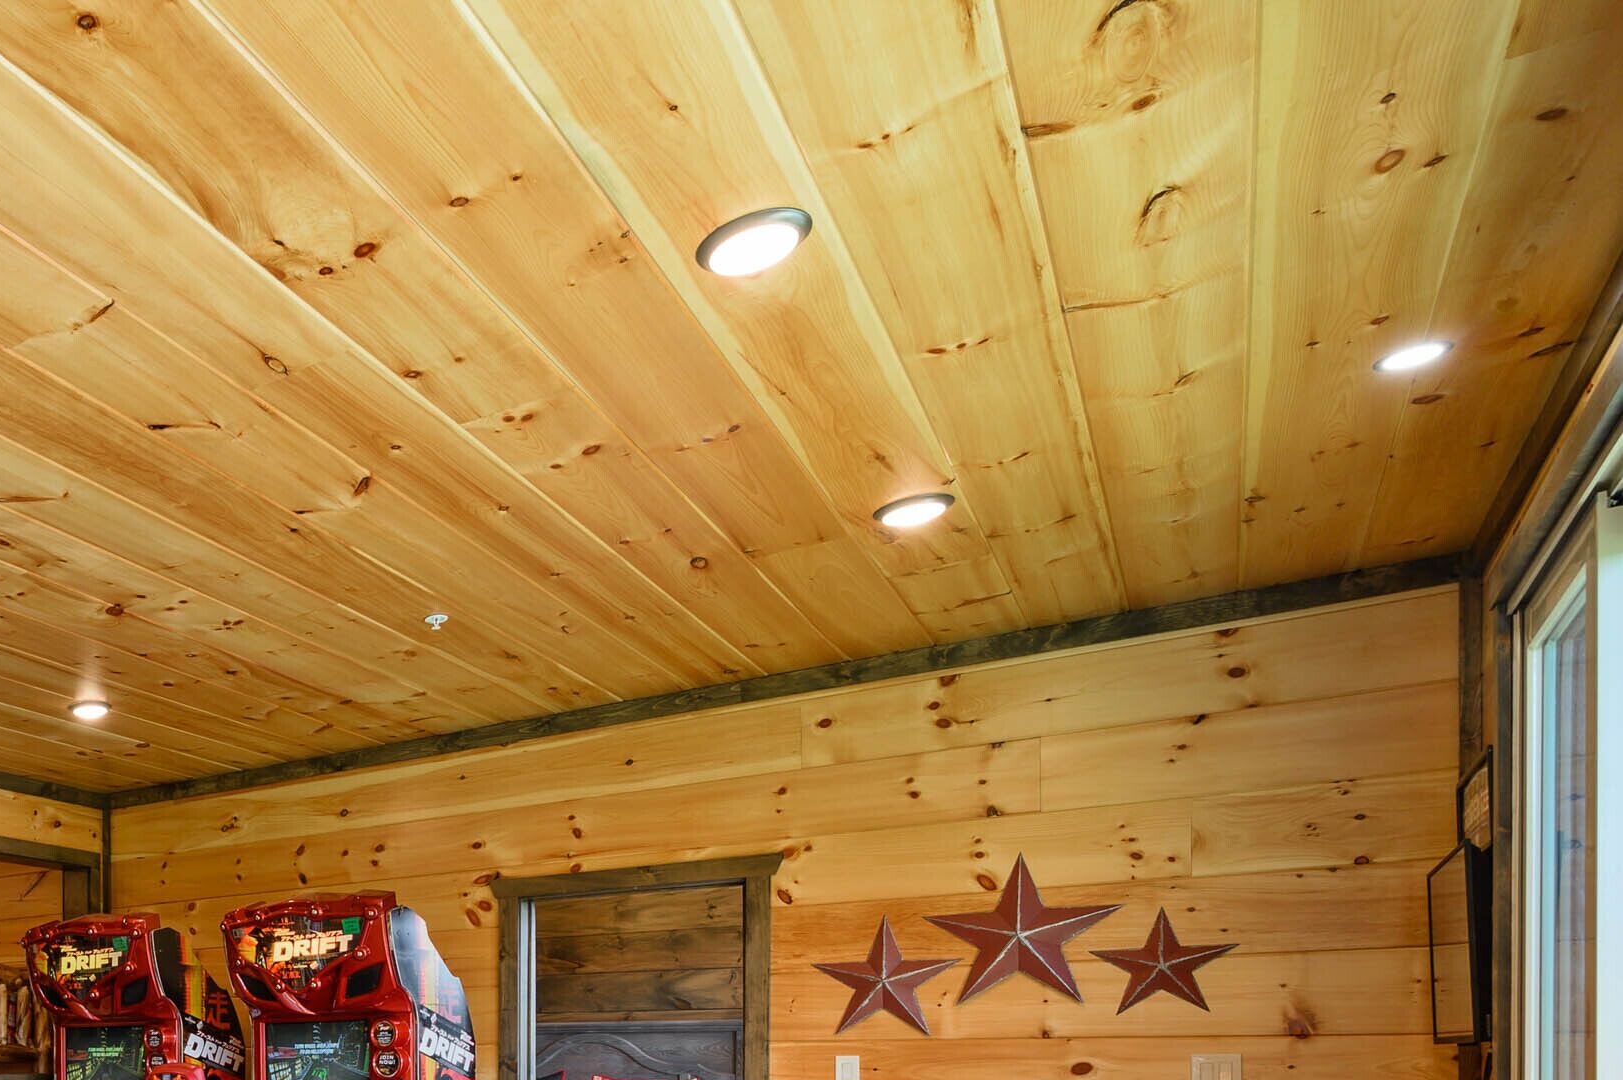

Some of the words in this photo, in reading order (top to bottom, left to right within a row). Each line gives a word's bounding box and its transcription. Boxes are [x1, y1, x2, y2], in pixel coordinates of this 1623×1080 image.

[61, 951, 123, 975] DRIFT
[271, 934, 354, 963] DRIFT
[184, 1033, 245, 1073] DRIFT
[419, 1027, 475, 1072] DRIFT
